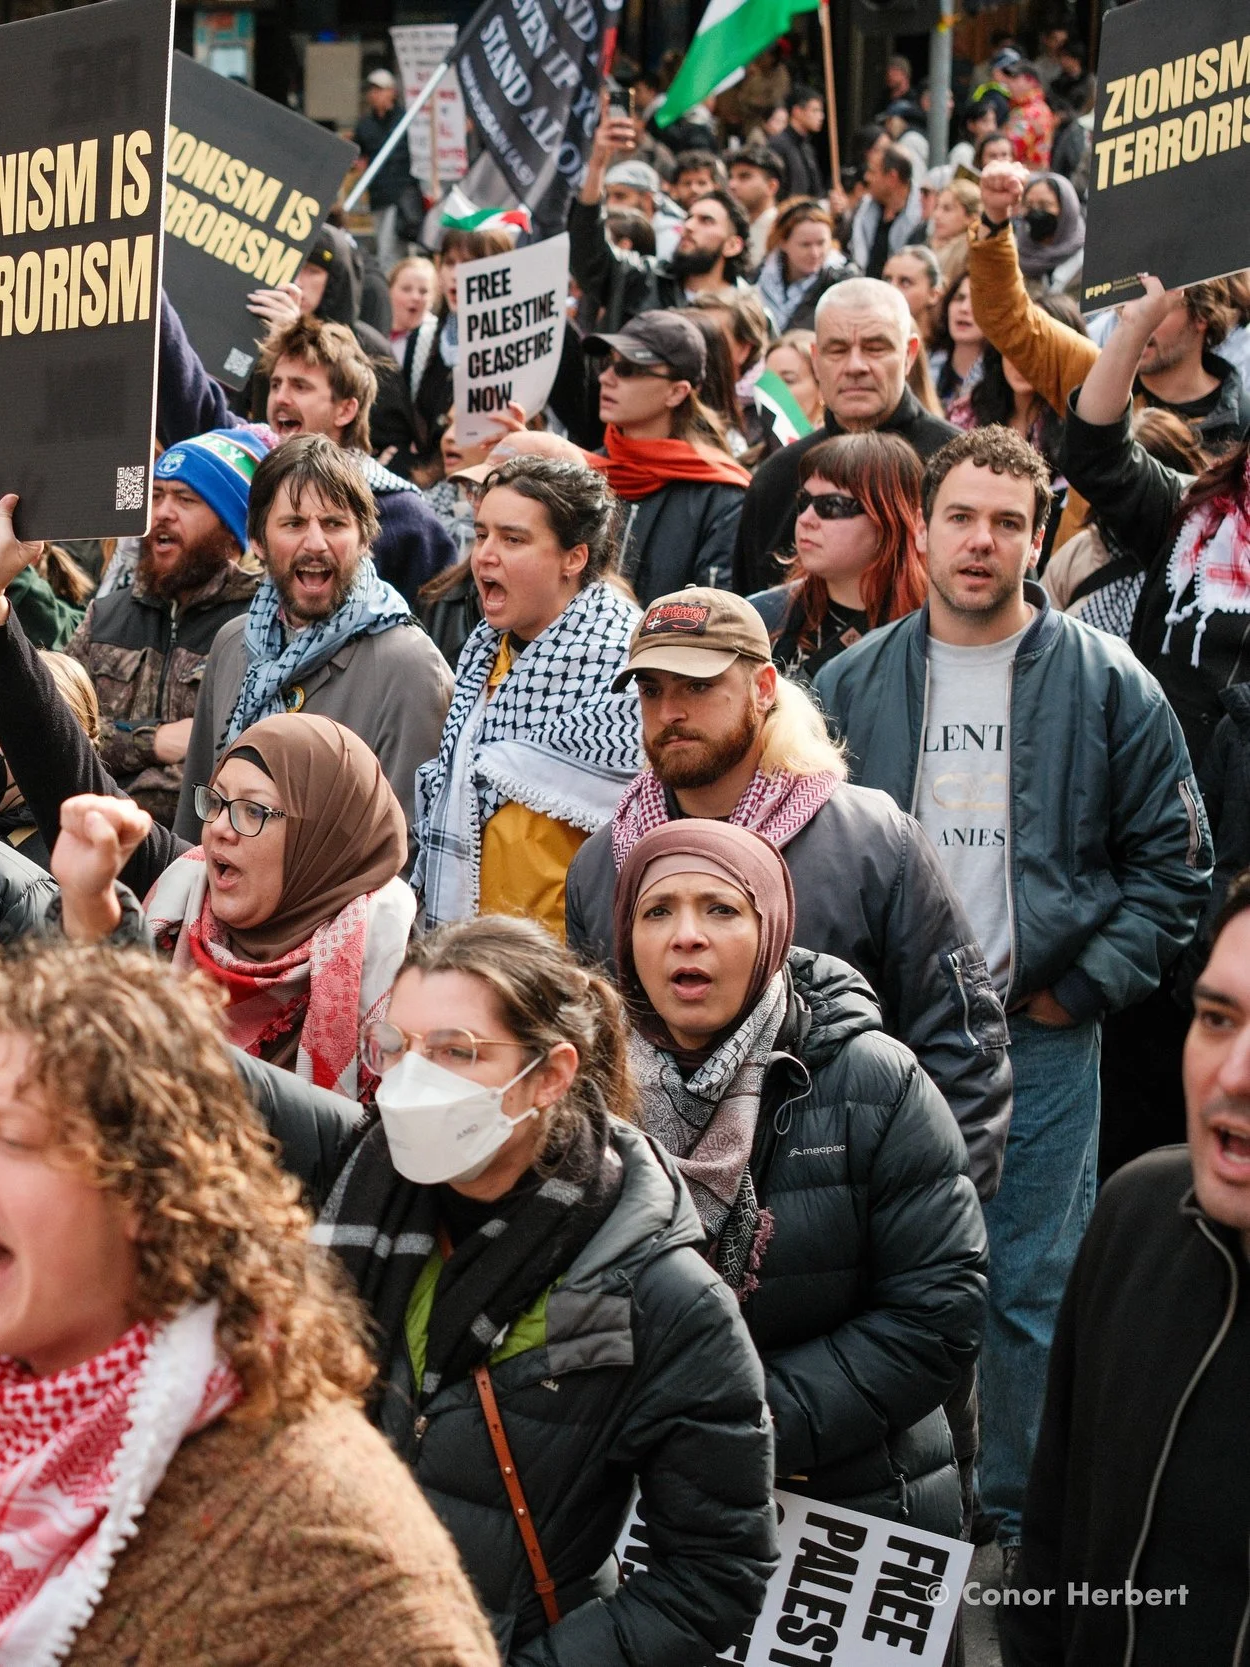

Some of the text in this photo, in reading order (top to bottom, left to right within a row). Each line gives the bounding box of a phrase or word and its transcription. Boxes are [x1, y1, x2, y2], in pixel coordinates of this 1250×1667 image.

[480, 14, 533, 107] STAND
[1102, 34, 1250, 132] ZIONISM
[110, 129, 152, 220] IS
[166, 124, 320, 241] ONISM IS
[466, 268, 511, 304] FREE
[467, 290, 559, 342] PALESTINE,
[468, 327, 555, 379] CEASEFIRE
[467, 381, 513, 413] NOW
[803, 1144, 846, 1155] macpac
[862, 1535, 950, 1656] FREE
